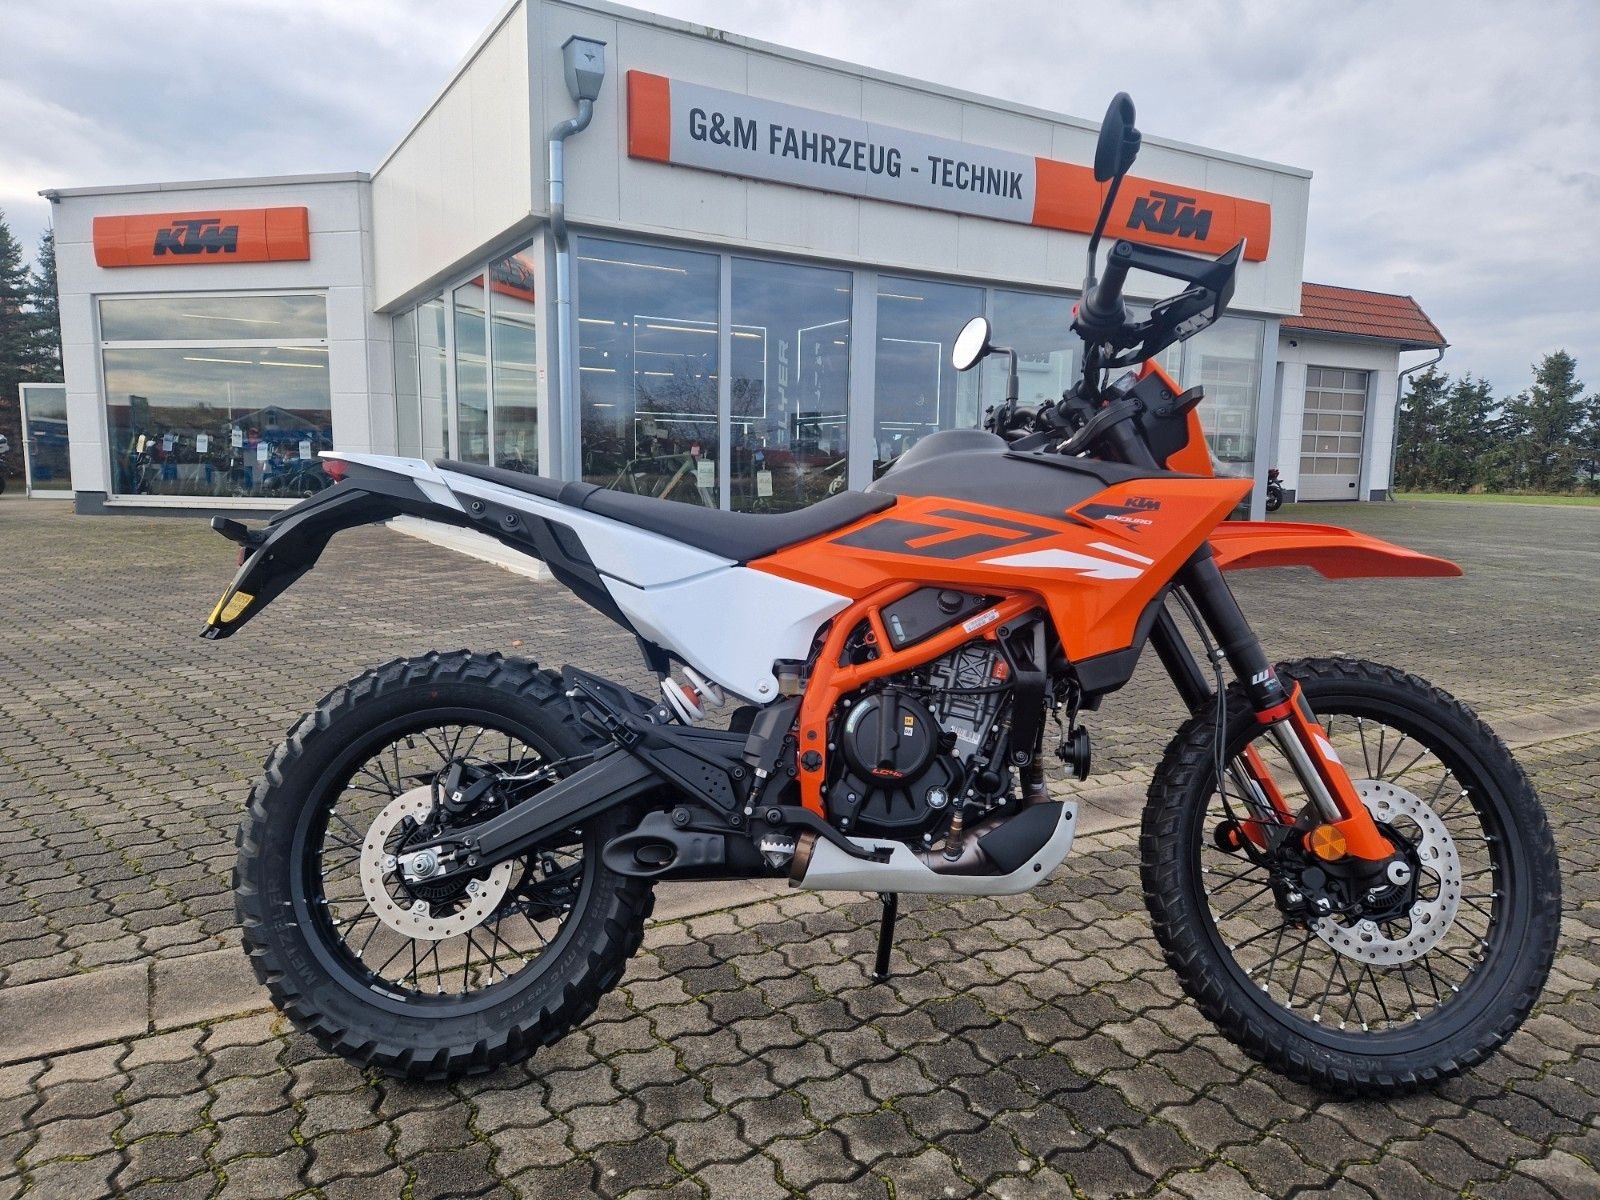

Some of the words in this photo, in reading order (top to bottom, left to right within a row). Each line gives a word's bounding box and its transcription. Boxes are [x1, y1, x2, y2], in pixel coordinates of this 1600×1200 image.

[688, 107, 758, 152] G&M
[768, 124, 902, 178] FAHRZEUG
[927, 155, 1023, 200] TECHNIK
[1127, 189, 1213, 241] KTM
[153, 218, 239, 256] KTM
[1104, 514, 1153, 525] ENDURO
[1123, 496, 1161, 510] KTM
